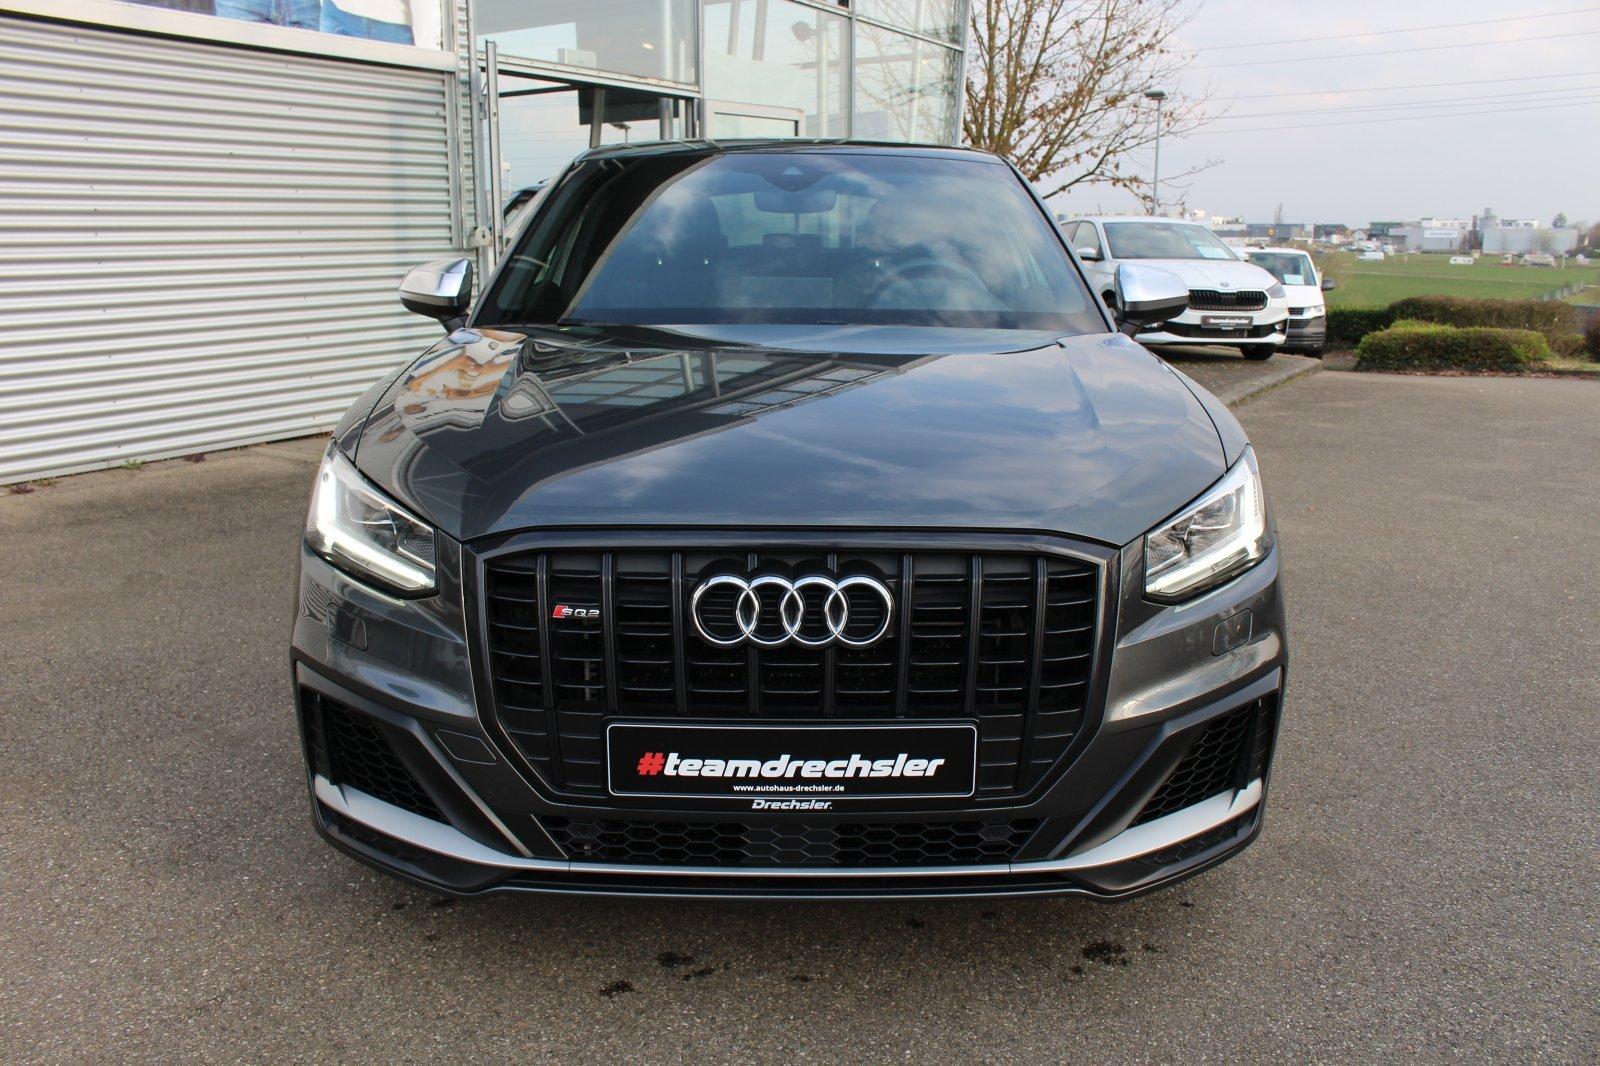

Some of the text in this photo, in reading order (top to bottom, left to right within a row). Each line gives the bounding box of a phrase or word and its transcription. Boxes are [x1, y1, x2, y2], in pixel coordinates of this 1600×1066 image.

[560, 607, 600, 618] SQ2
[636, 752, 946, 778] #teamdrechsler
[733, 784, 845, 792] www.autohaus-drechsler.de
